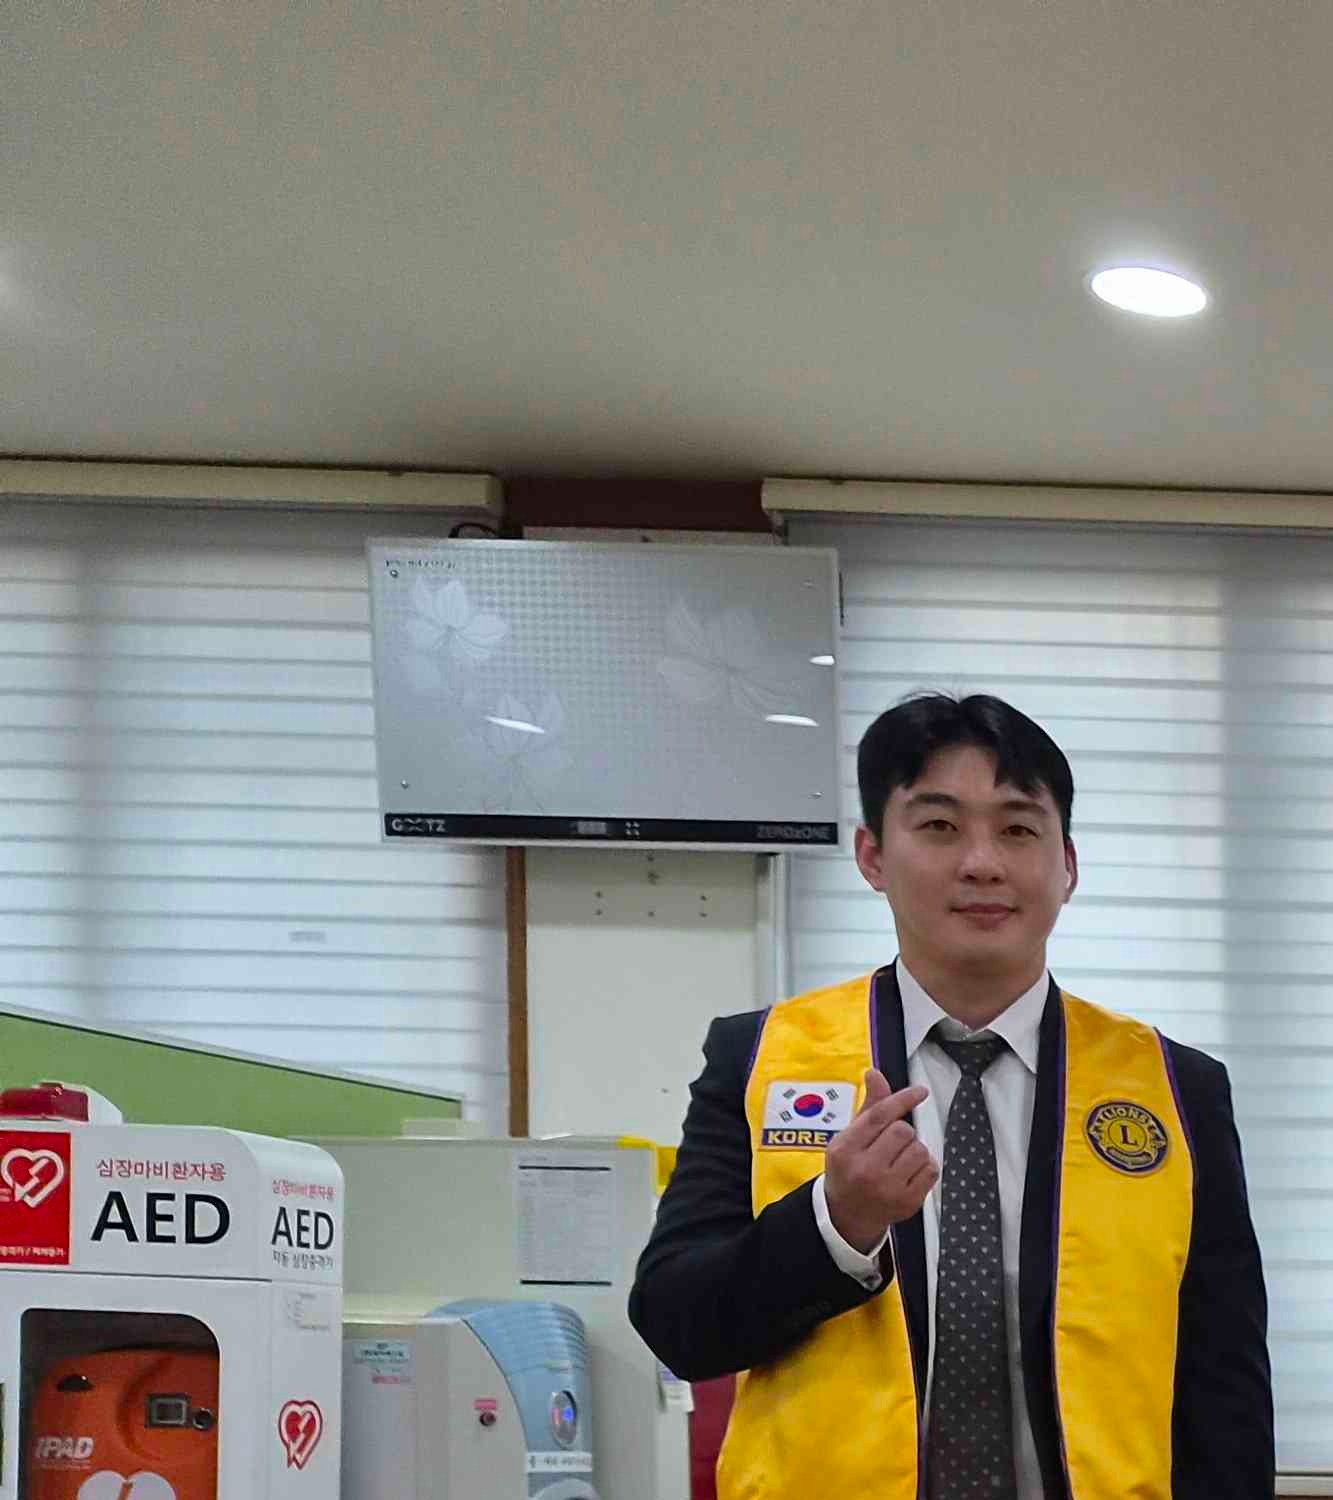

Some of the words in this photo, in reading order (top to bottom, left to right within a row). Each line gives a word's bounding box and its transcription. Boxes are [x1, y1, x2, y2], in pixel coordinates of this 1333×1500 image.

[1103, 1107, 1148, 1124] LIONS
[768, 1130, 834, 1145] KORE
[1120, 1125, 1138, 1145] L
[91, 1191, 230, 1245] AED
[272, 1206, 333, 1250] AED
